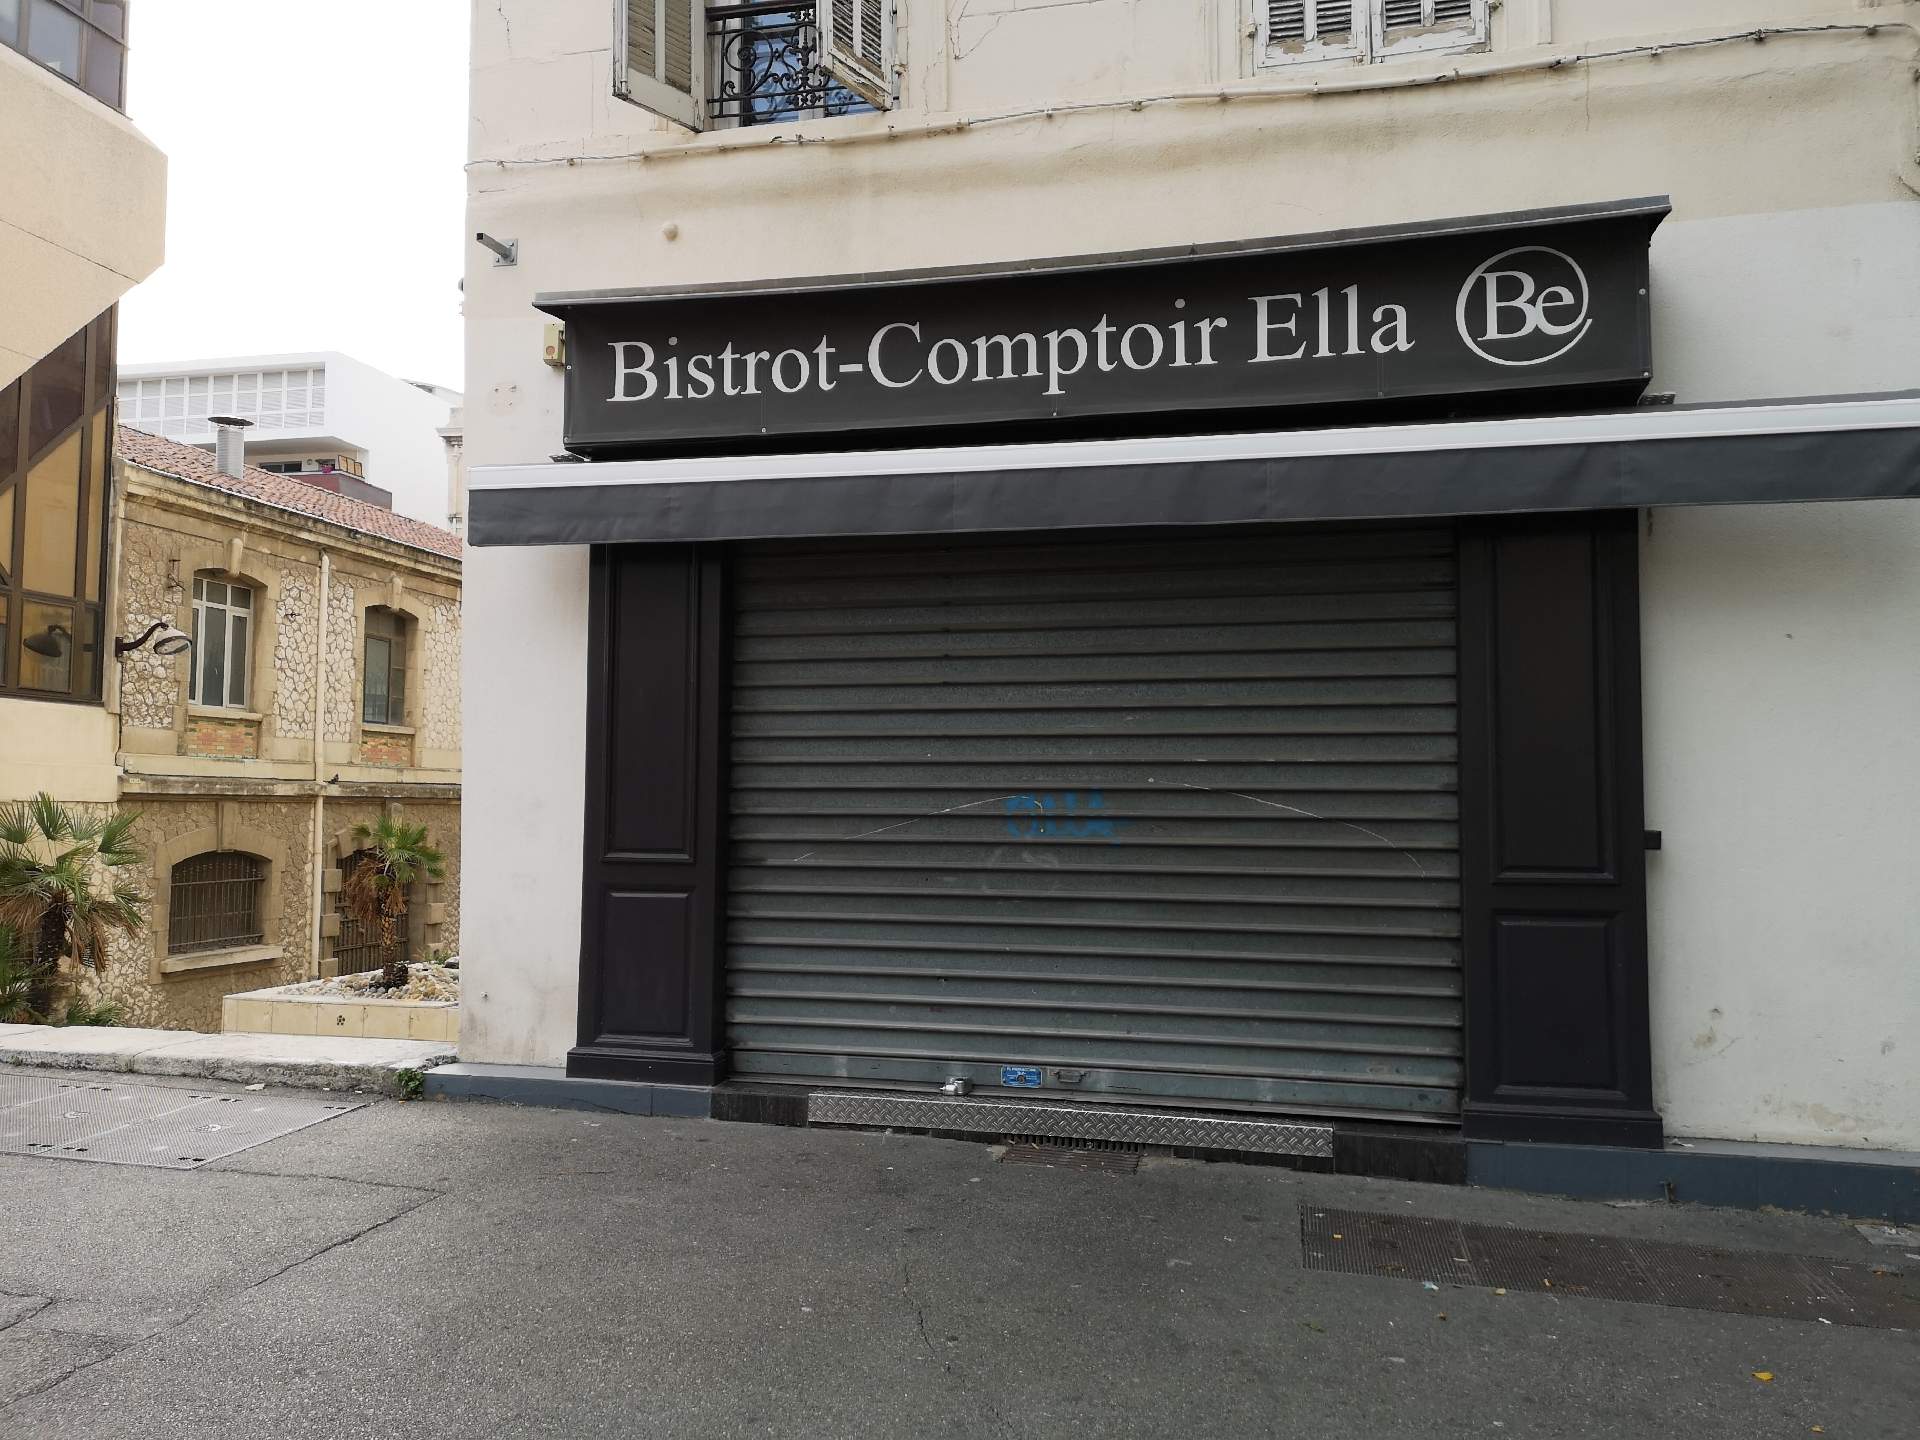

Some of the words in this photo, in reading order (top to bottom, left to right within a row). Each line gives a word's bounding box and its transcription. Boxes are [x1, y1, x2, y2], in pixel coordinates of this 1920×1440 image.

[605, 298, 1228, 402] Bistrot-Comptoir
[1247, 284, 1416, 363] Ella
[1477, 270, 1580, 341] Be
